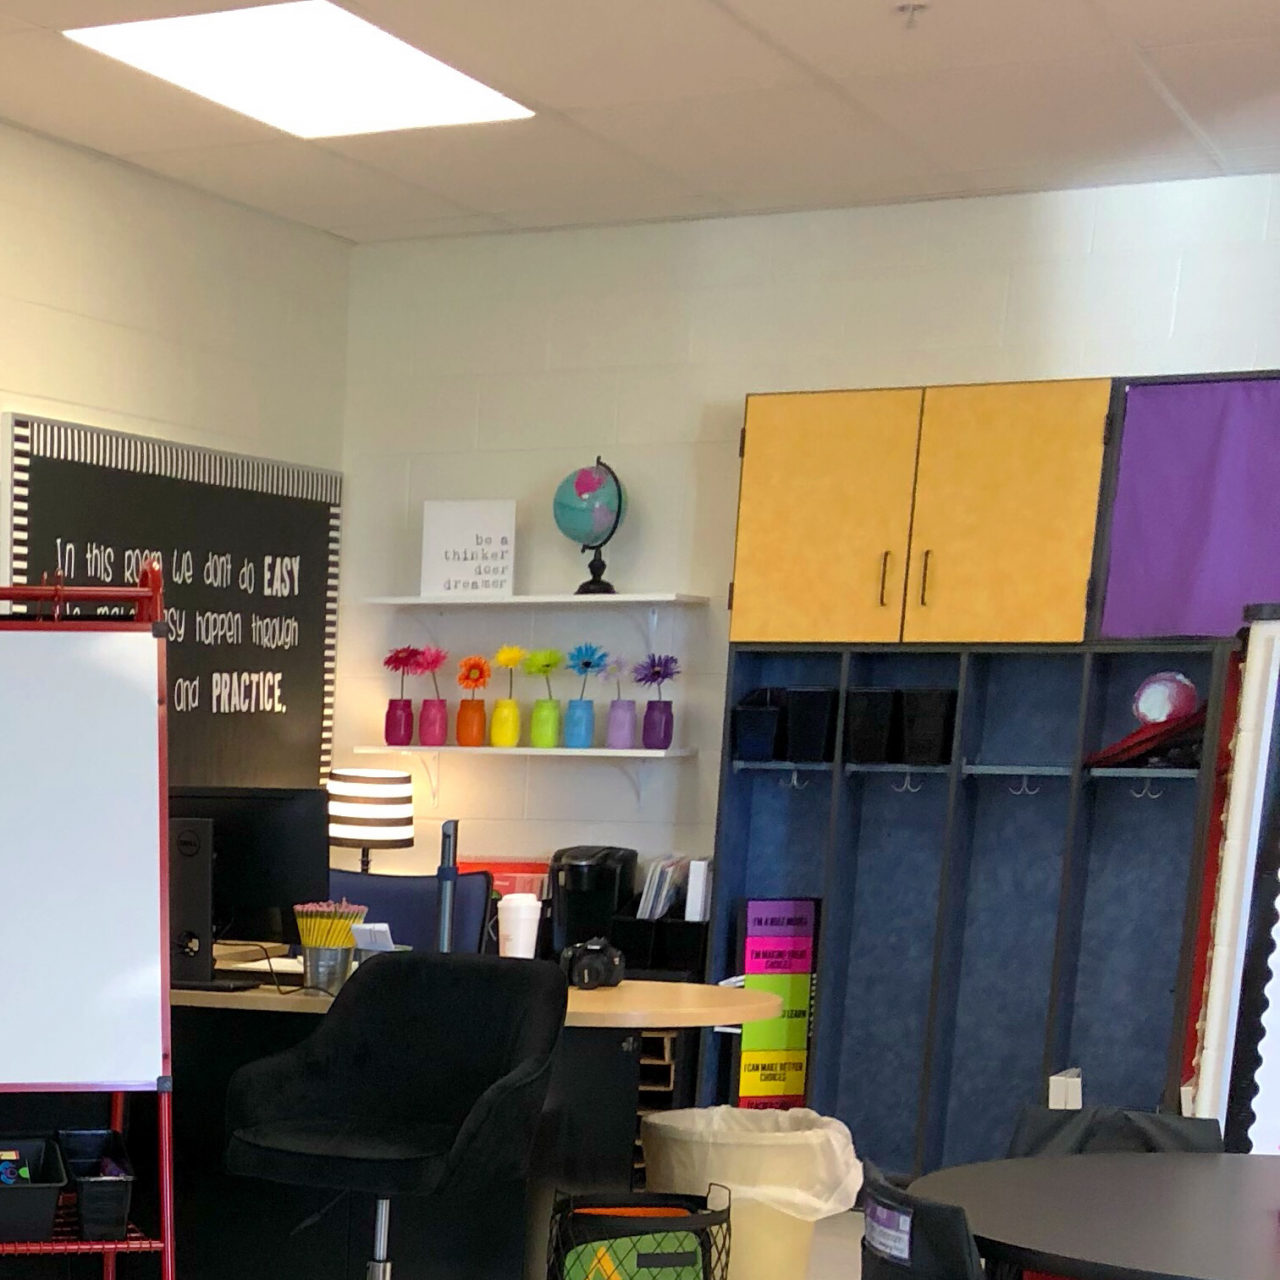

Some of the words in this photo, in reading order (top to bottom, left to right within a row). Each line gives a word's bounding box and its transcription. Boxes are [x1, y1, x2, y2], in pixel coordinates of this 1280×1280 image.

[475, 533, 493, 546] be
[500, 536, 509, 546] a
[444, 548, 509, 561] thinker
[56, 538, 75, 579] In
[85, 542, 115, 582] this
[238, 557, 255, 595] do
[263, 555, 300, 597] EASY
[474, 564, 509, 575] doer
[443, 578, 507, 590] dreamer
[195, 610, 242, 646] happen
[174, 675, 200, 712] and
[211, 671, 287, 713] PRACTICE.
[747, 1063, 760, 1072] CAN
[761, 1063, 778, 1072] MAKE
